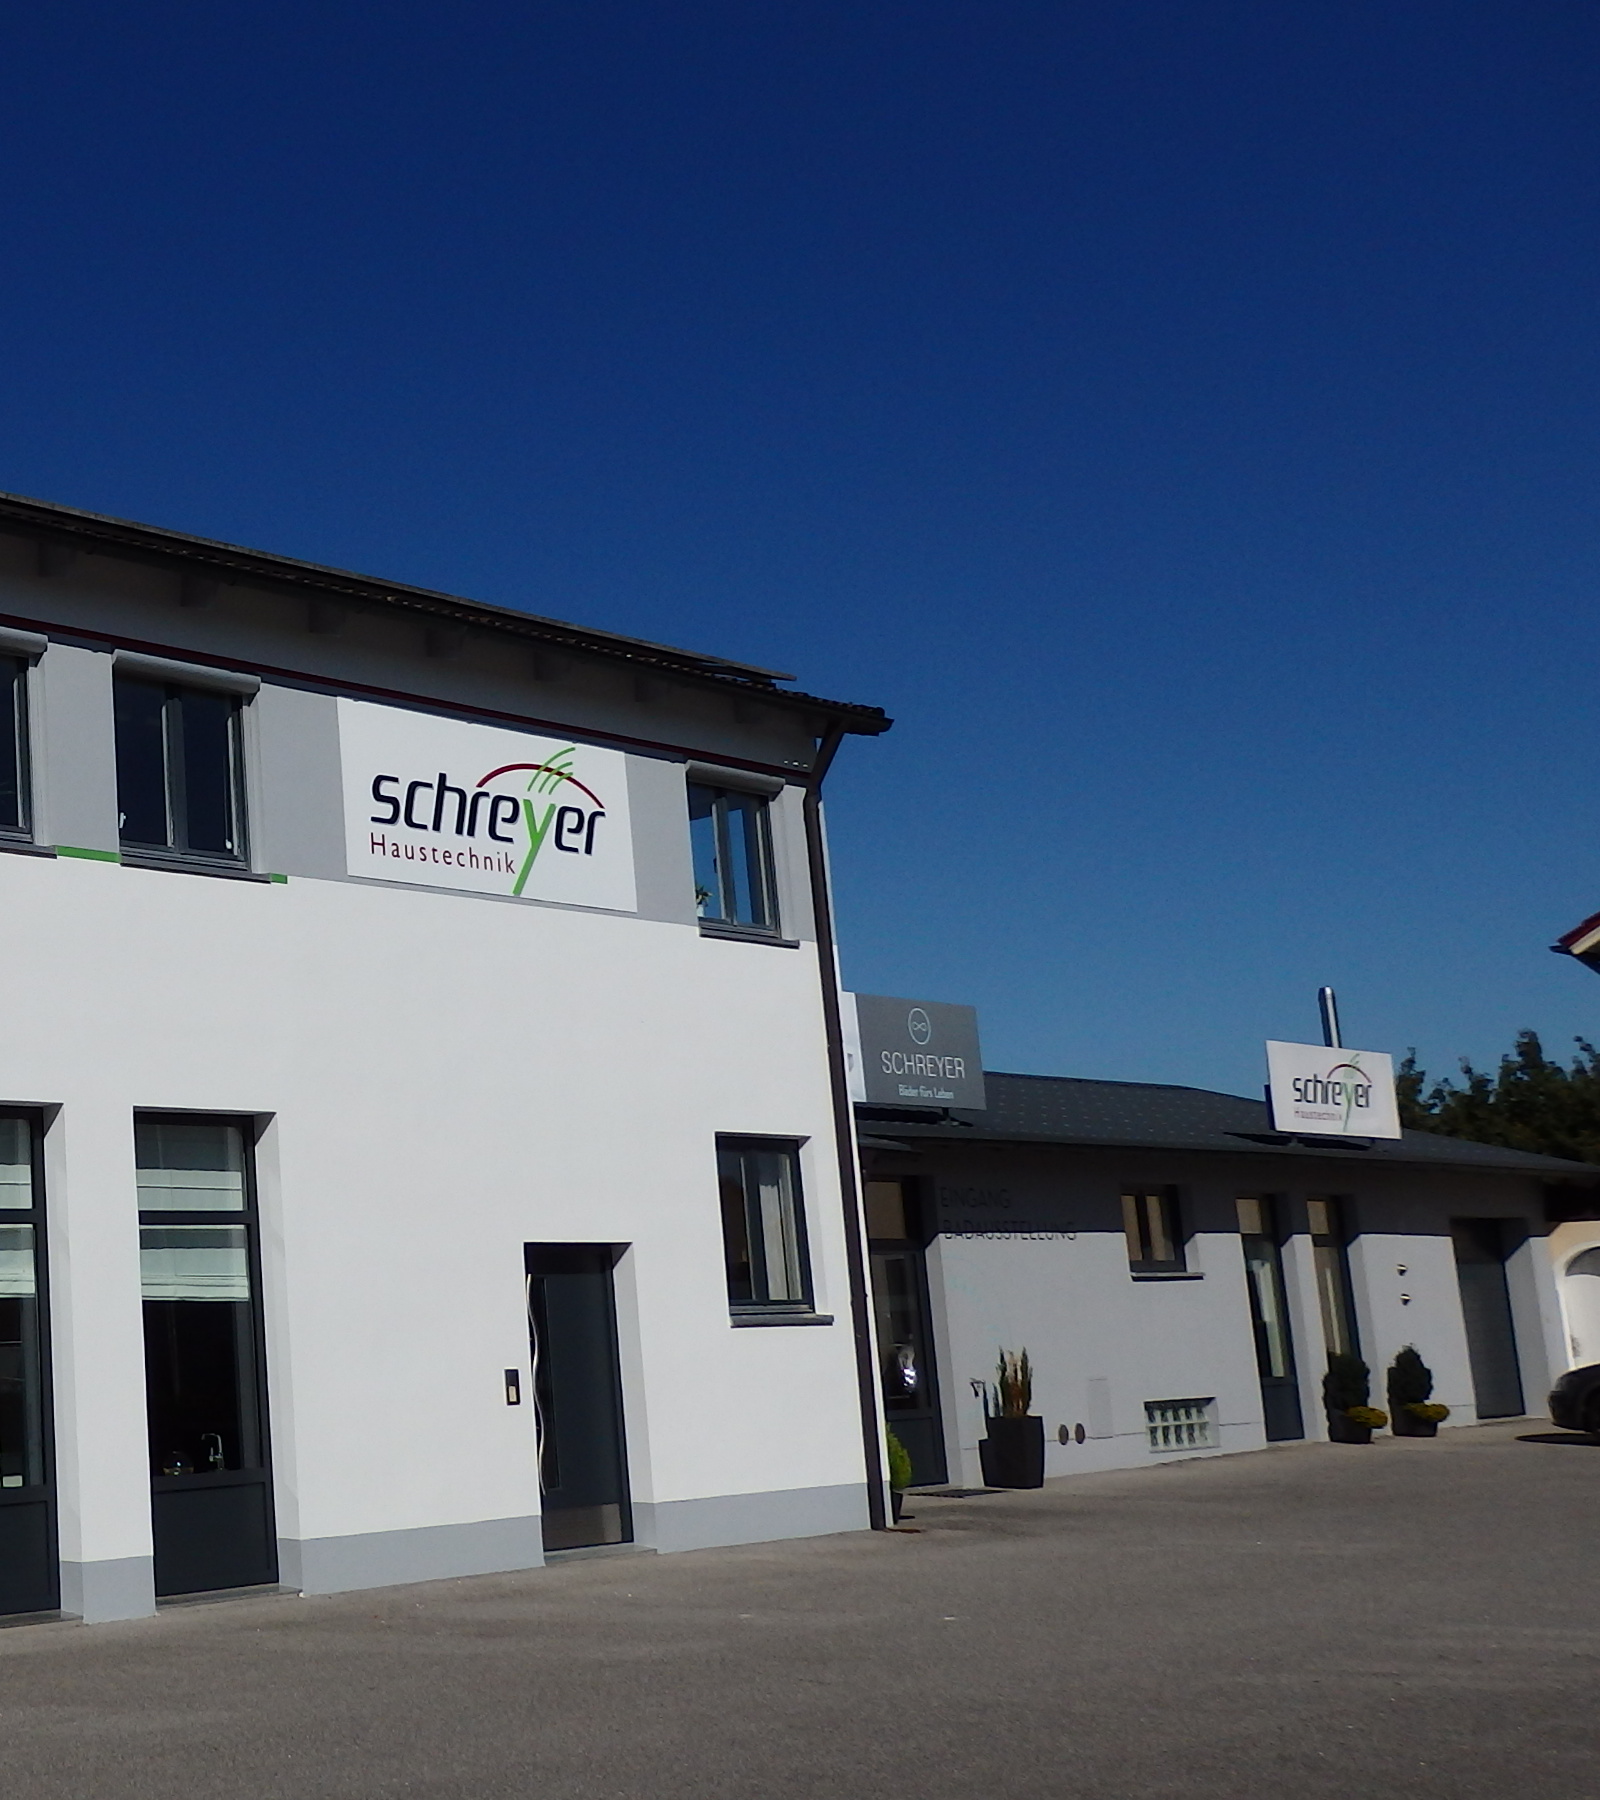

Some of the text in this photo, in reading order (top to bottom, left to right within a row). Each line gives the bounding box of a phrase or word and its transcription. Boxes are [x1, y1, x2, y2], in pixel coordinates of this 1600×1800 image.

[370, 772, 606, 896] schreyer
[369, 832, 516, 875] Haustechnik
[881, 1050, 966, 1079] SCHREYER
[1293, 1074, 1372, 1132] schreyer
[939, 1186, 1011, 1209] EINGANG
[942, 1219, 1077, 1241] BADAUSSTELLUNG
